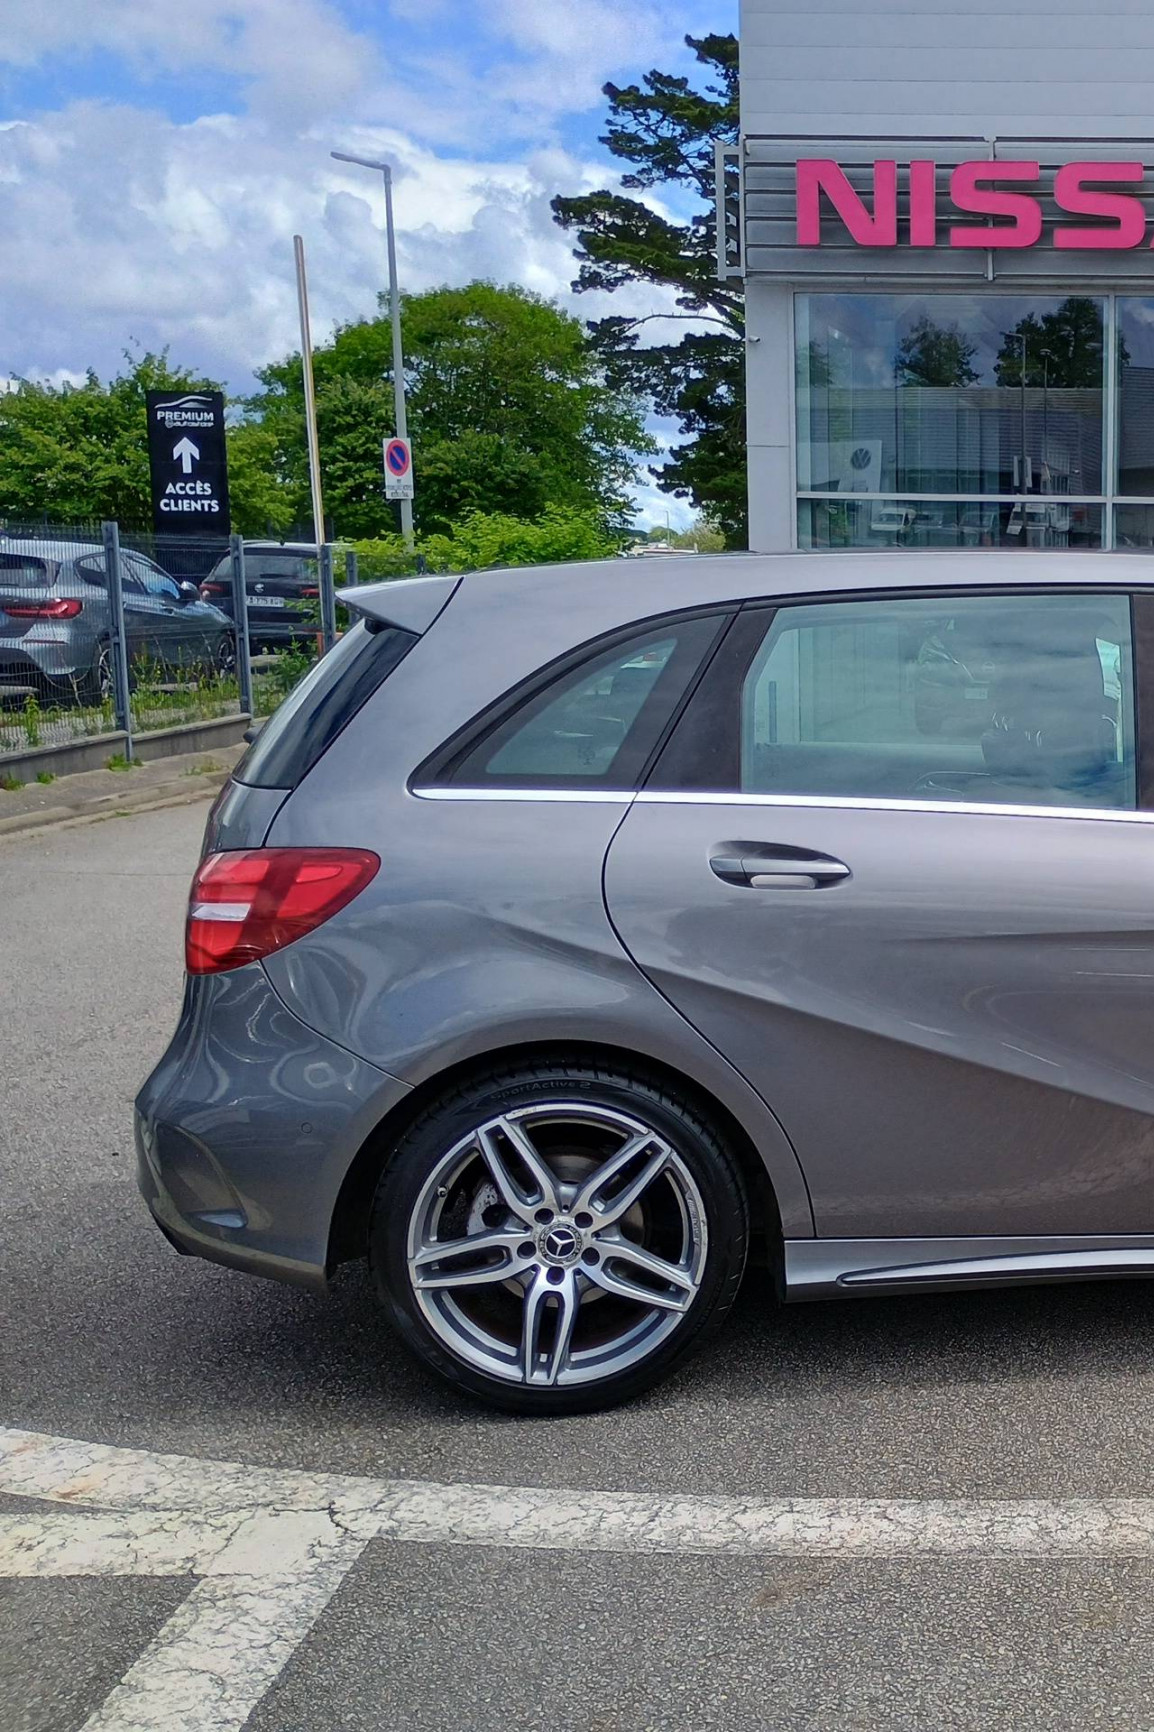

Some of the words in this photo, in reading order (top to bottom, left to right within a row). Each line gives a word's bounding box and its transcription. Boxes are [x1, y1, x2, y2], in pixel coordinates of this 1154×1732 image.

[157, 411, 214, 421] PREMIUM
[165, 480, 212, 495] ACCÈS
[160, 499, 219, 512] CLIENTS
